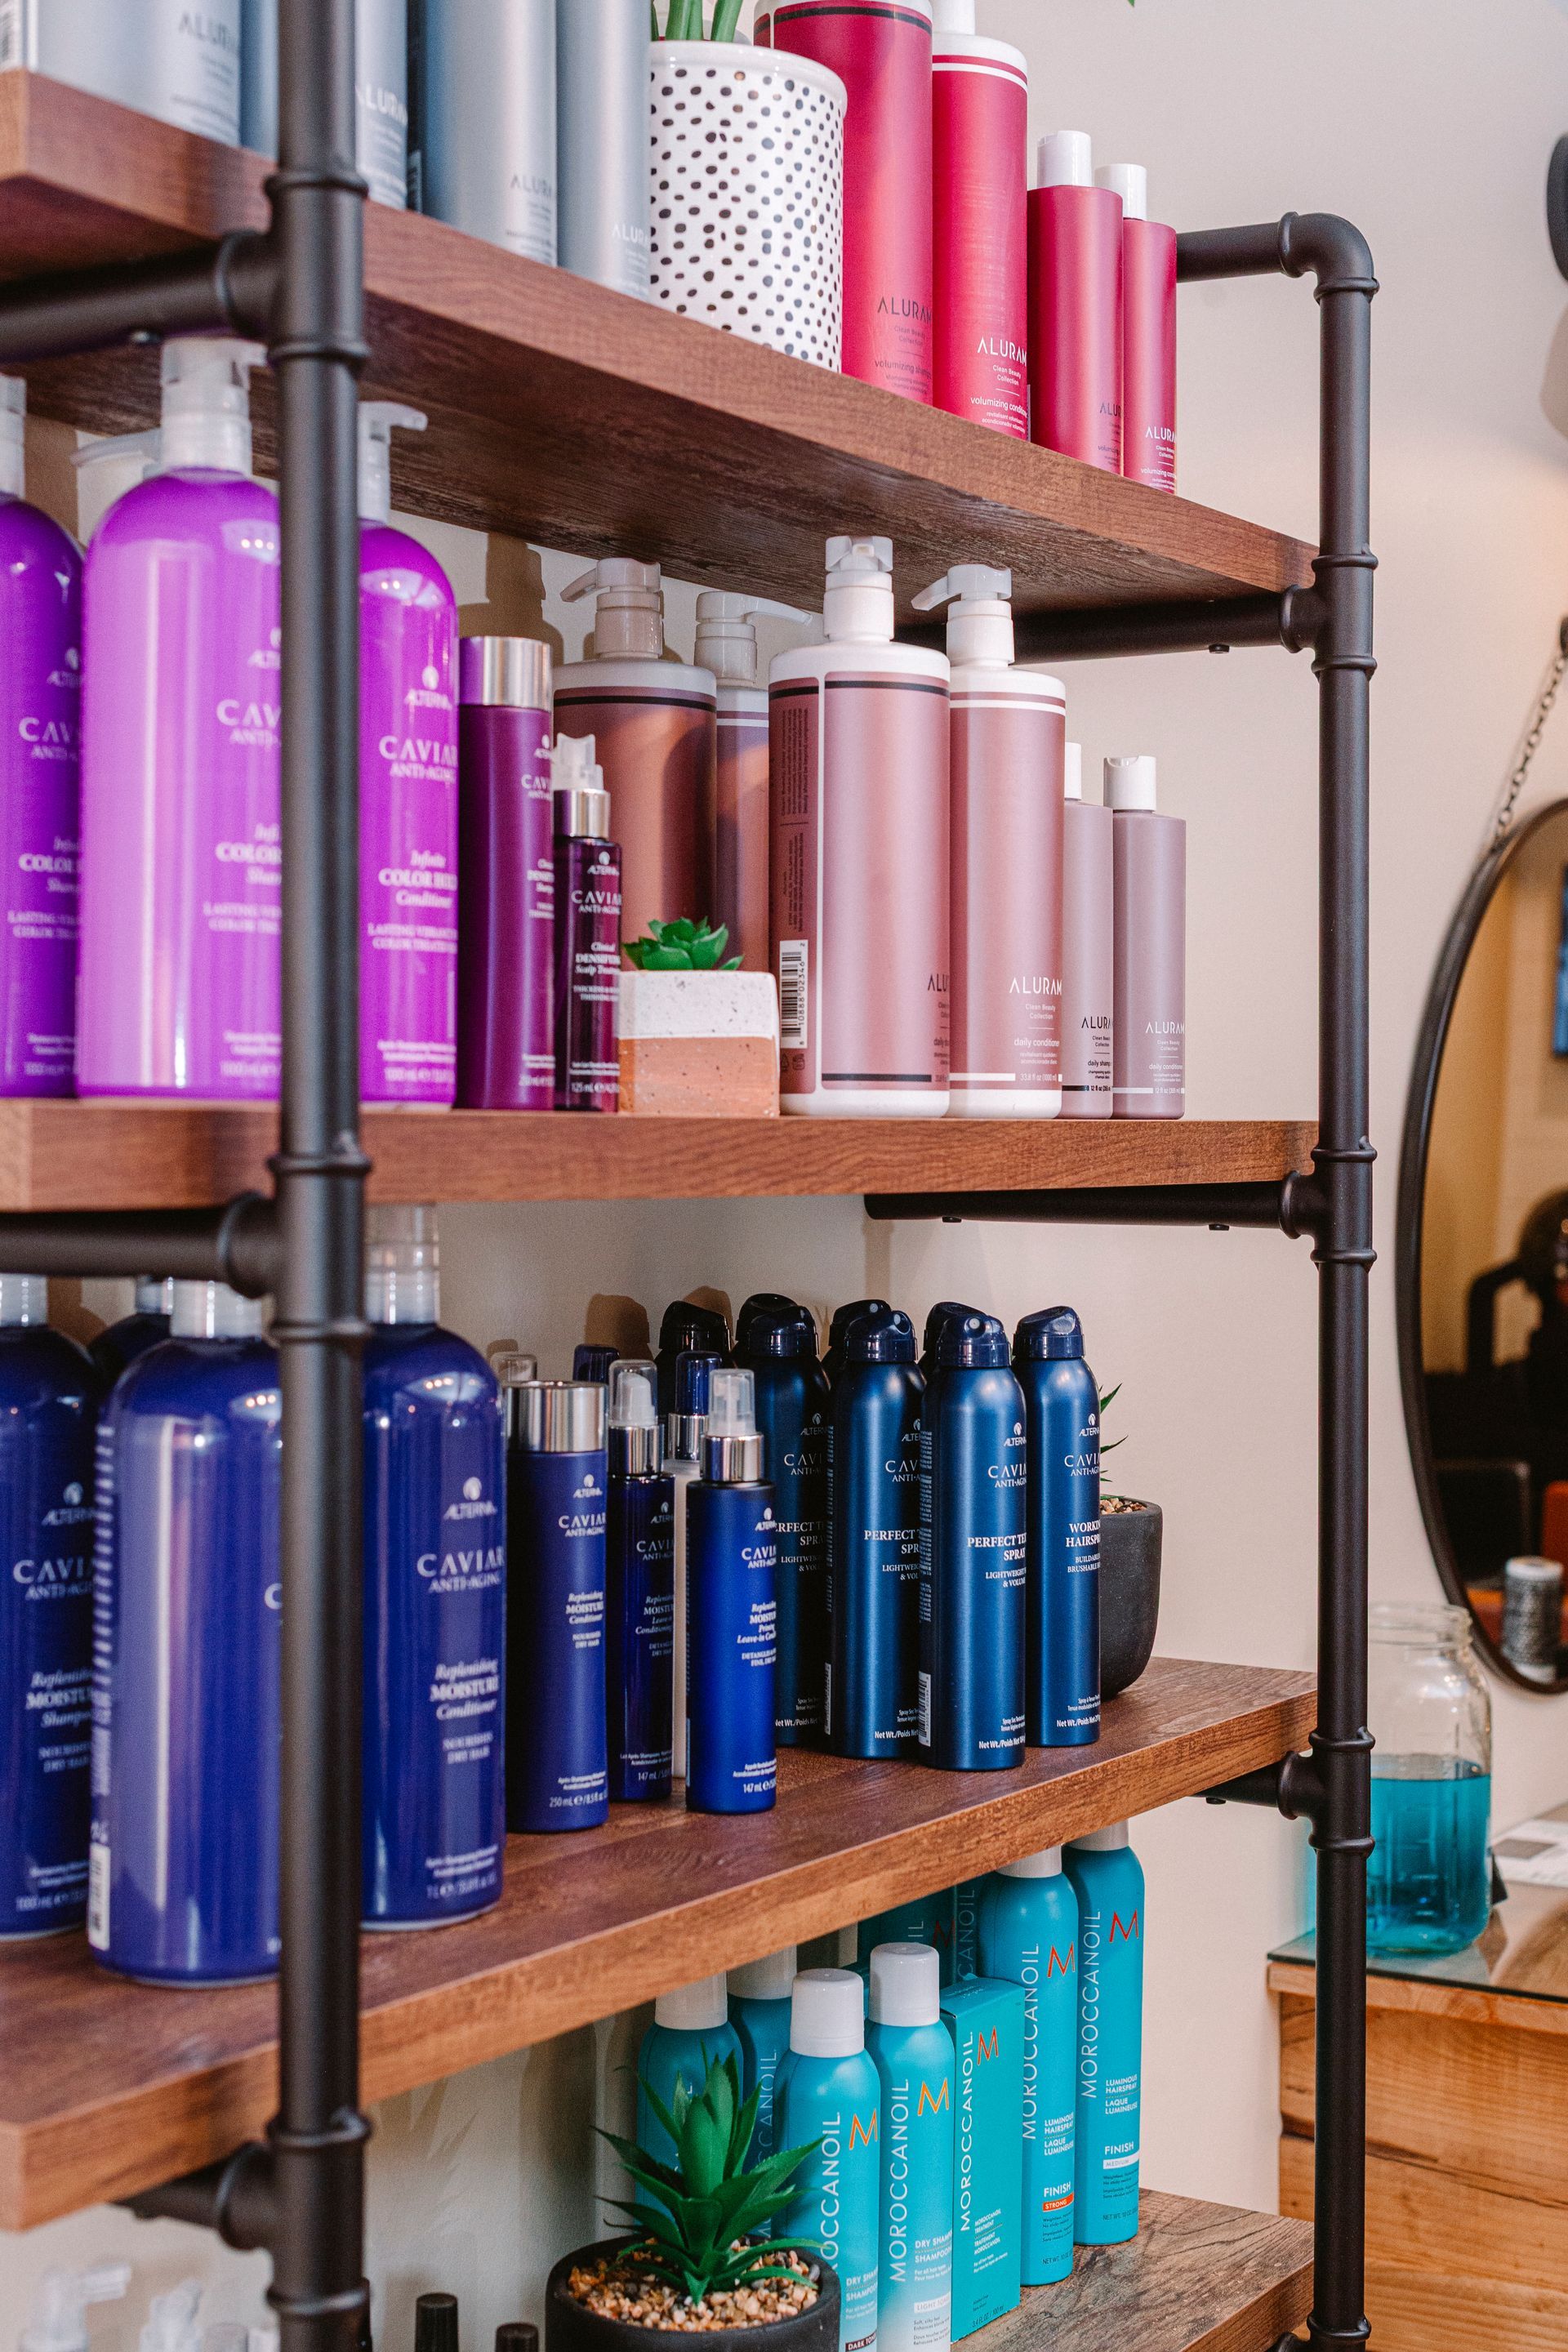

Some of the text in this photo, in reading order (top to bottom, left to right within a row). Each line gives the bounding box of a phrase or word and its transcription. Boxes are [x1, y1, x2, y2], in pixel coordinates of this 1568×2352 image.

[992, 364, 1008, 374] Clean
[996, 375, 1019, 386] Collection
[970, 396, 1009, 412] volumizing
[378, 867, 433, 889] COLOR
[1013, 1038, 1031, 1049] daily
[885, 1459, 919, 1473] CAV
[775, 1521, 815, 1533] RFECT
[864, 1529, 915, 1541] PERFECT
[967, 1534, 1017, 1548] PERFECT
[901, 1543, 920, 1555] SPR
[1057, 1717, 1089, 1728] Net Wt./Poids
[875, 1731, 883, 1739] Net
[884, 1730, 911, 1740] Wt./Poids
[978, 1740, 988, 1749] Net
[638, 1772, 648, 1781] 147
[743, 1783, 753, 1793] 147
[1109, 1908, 1139, 1943] M
[1047, 1941, 1076, 1978] M
[1080, 1909, 1101, 2099] MOROCCANOIL
[977, 2025, 999, 2066] M
[1022, 1944, 1040, 2140] MOROCCANOIL
[1105, 2074, 1138, 2087] LUMINOUS
[1105, 2082, 1137, 2094] HAIRSPRAY
[917, 2077, 949, 2116] M
[1105, 2097, 1128, 2106] LAQUE
[1105, 2101, 1138, 2114] LUMINEUSE
[1044, 2111, 1074, 2127] LUMINOUS
[849, 2107, 878, 2150] M
[960, 2032, 973, 2231] MOROCCANOIL
[1044, 2121, 1074, 2135] HAIRSPRAY
[1044, 2137, 1066, 2148] LAQUE
[1044, 2140, 1074, 2156] LUMINEUSE
[1104, 2140, 1134, 2155] FINISH
[1105, 2158, 1129, 2167] MEDIUM
[889, 2079, 909, 2282] MOROCCANOIL
[820, 2112, 840, 2274] OCCANOIL
[1043, 2180, 1071, 2198] FINISH
[1045, 2199, 1067, 2210] STRONG
[974, 2207, 1001, 2227] MOROCCANOIL
[974, 2219, 995, 2234] TREATMENT
[915, 2238, 930, 2249] DRY
[973, 2236, 1000, 2256] MOROCCANOIL
[974, 2231, 996, 2247] TRAITEMENT
[846, 2276, 862, 2287] DRY
[916, 2303, 935, 2311] LIGHT
[848, 2339, 866, 2350] DARK
